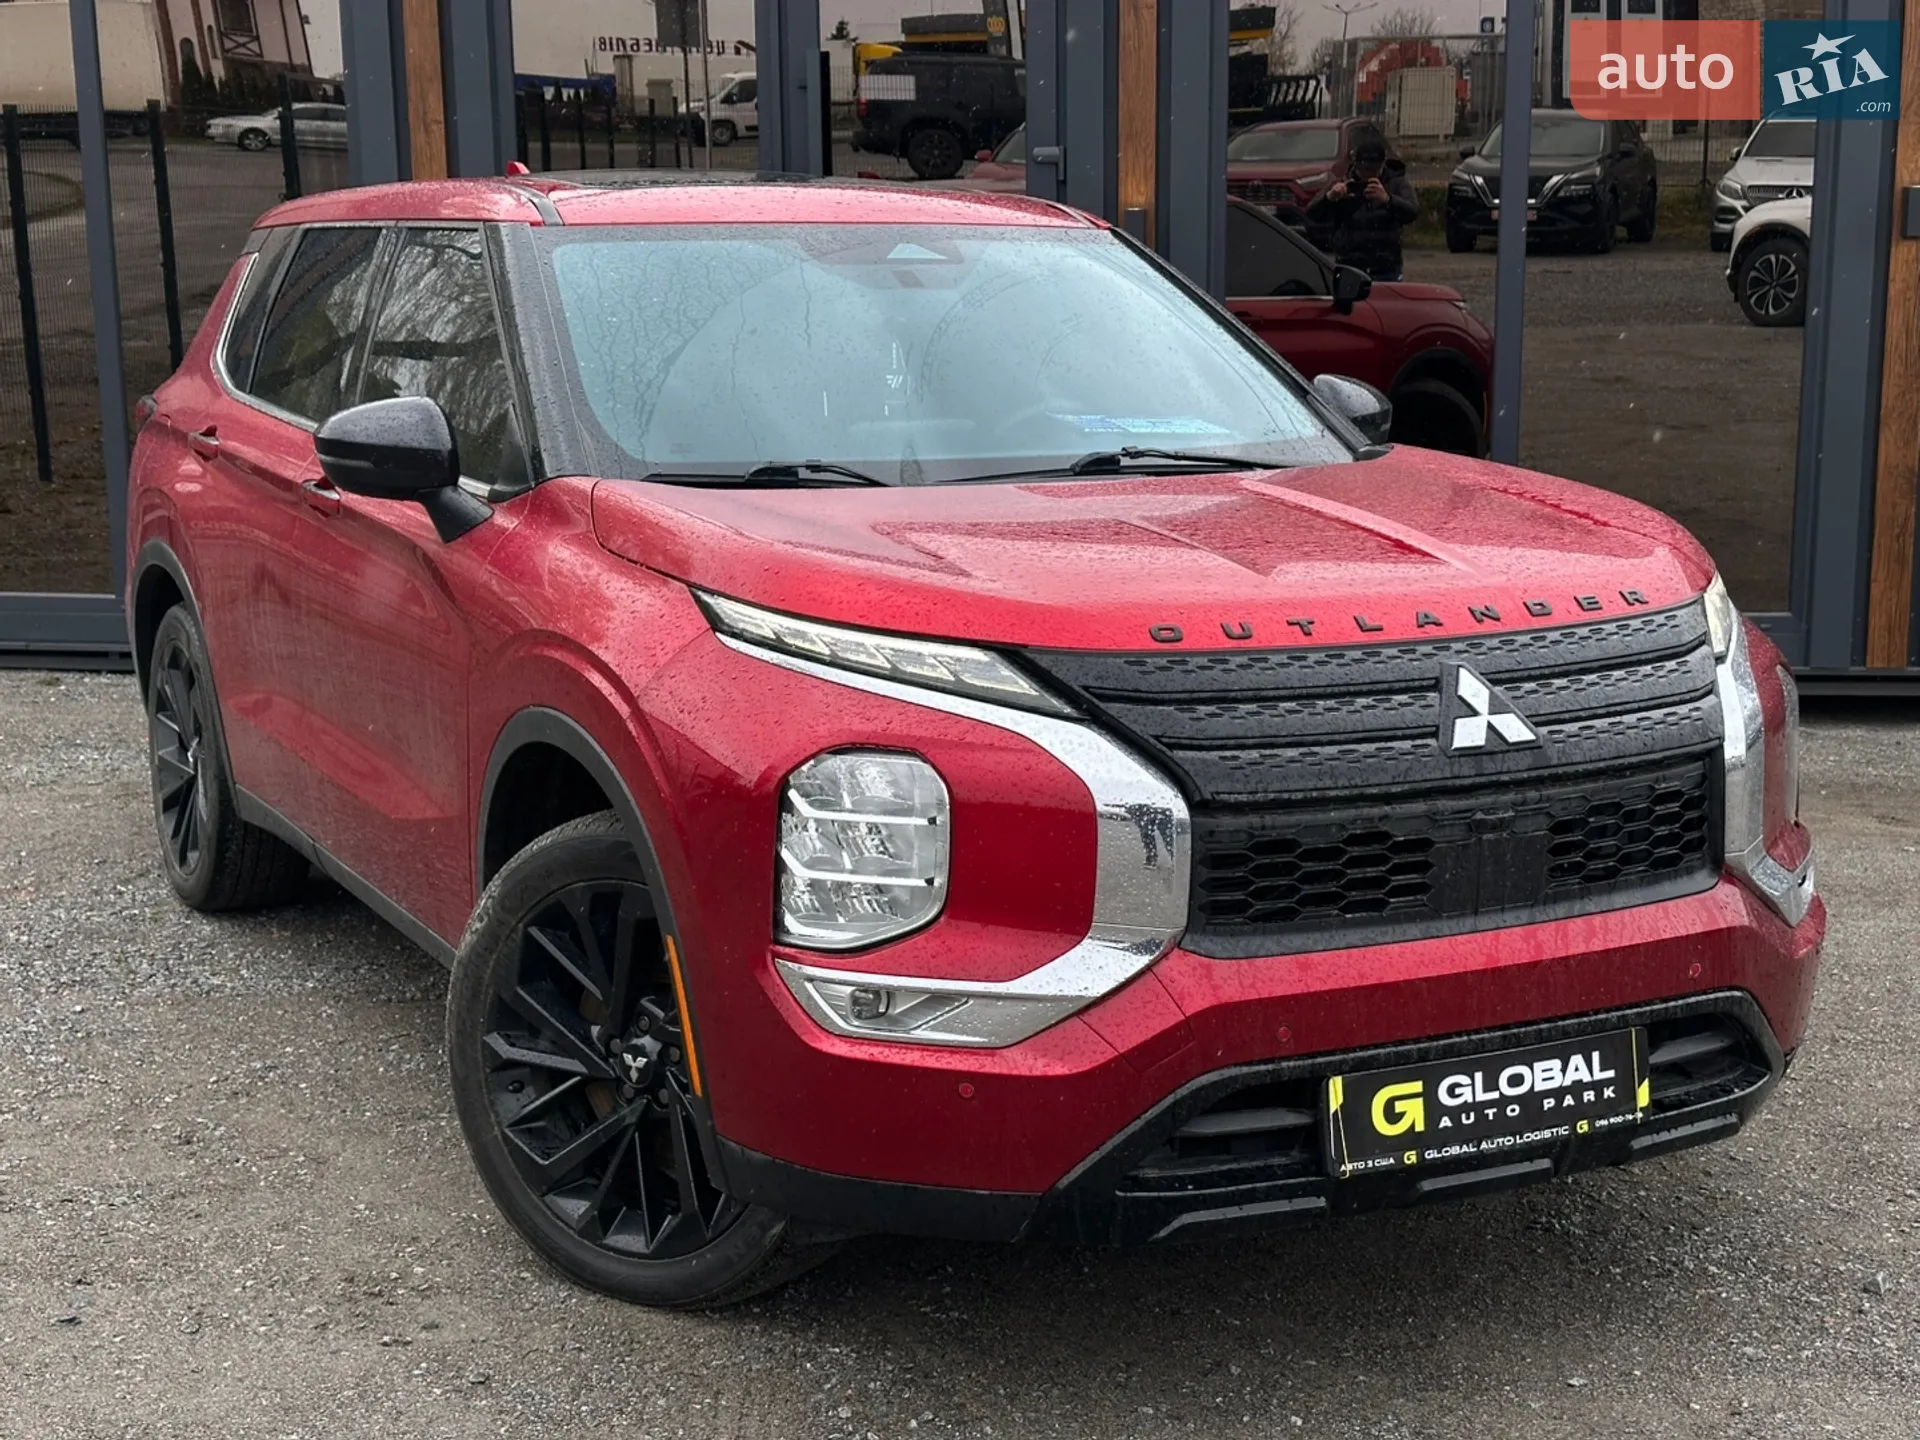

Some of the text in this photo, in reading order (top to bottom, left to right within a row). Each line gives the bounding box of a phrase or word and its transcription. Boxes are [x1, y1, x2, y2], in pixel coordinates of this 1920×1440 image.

[1148, 588, 1650, 643] OUTLANDER
[1437, 1050, 1616, 1106] GLOBAL
[1438, 1086, 1617, 1129] AUTO PARK
[1424, 1125, 1570, 1159] GLOBAL AUTO LOGISTIC
